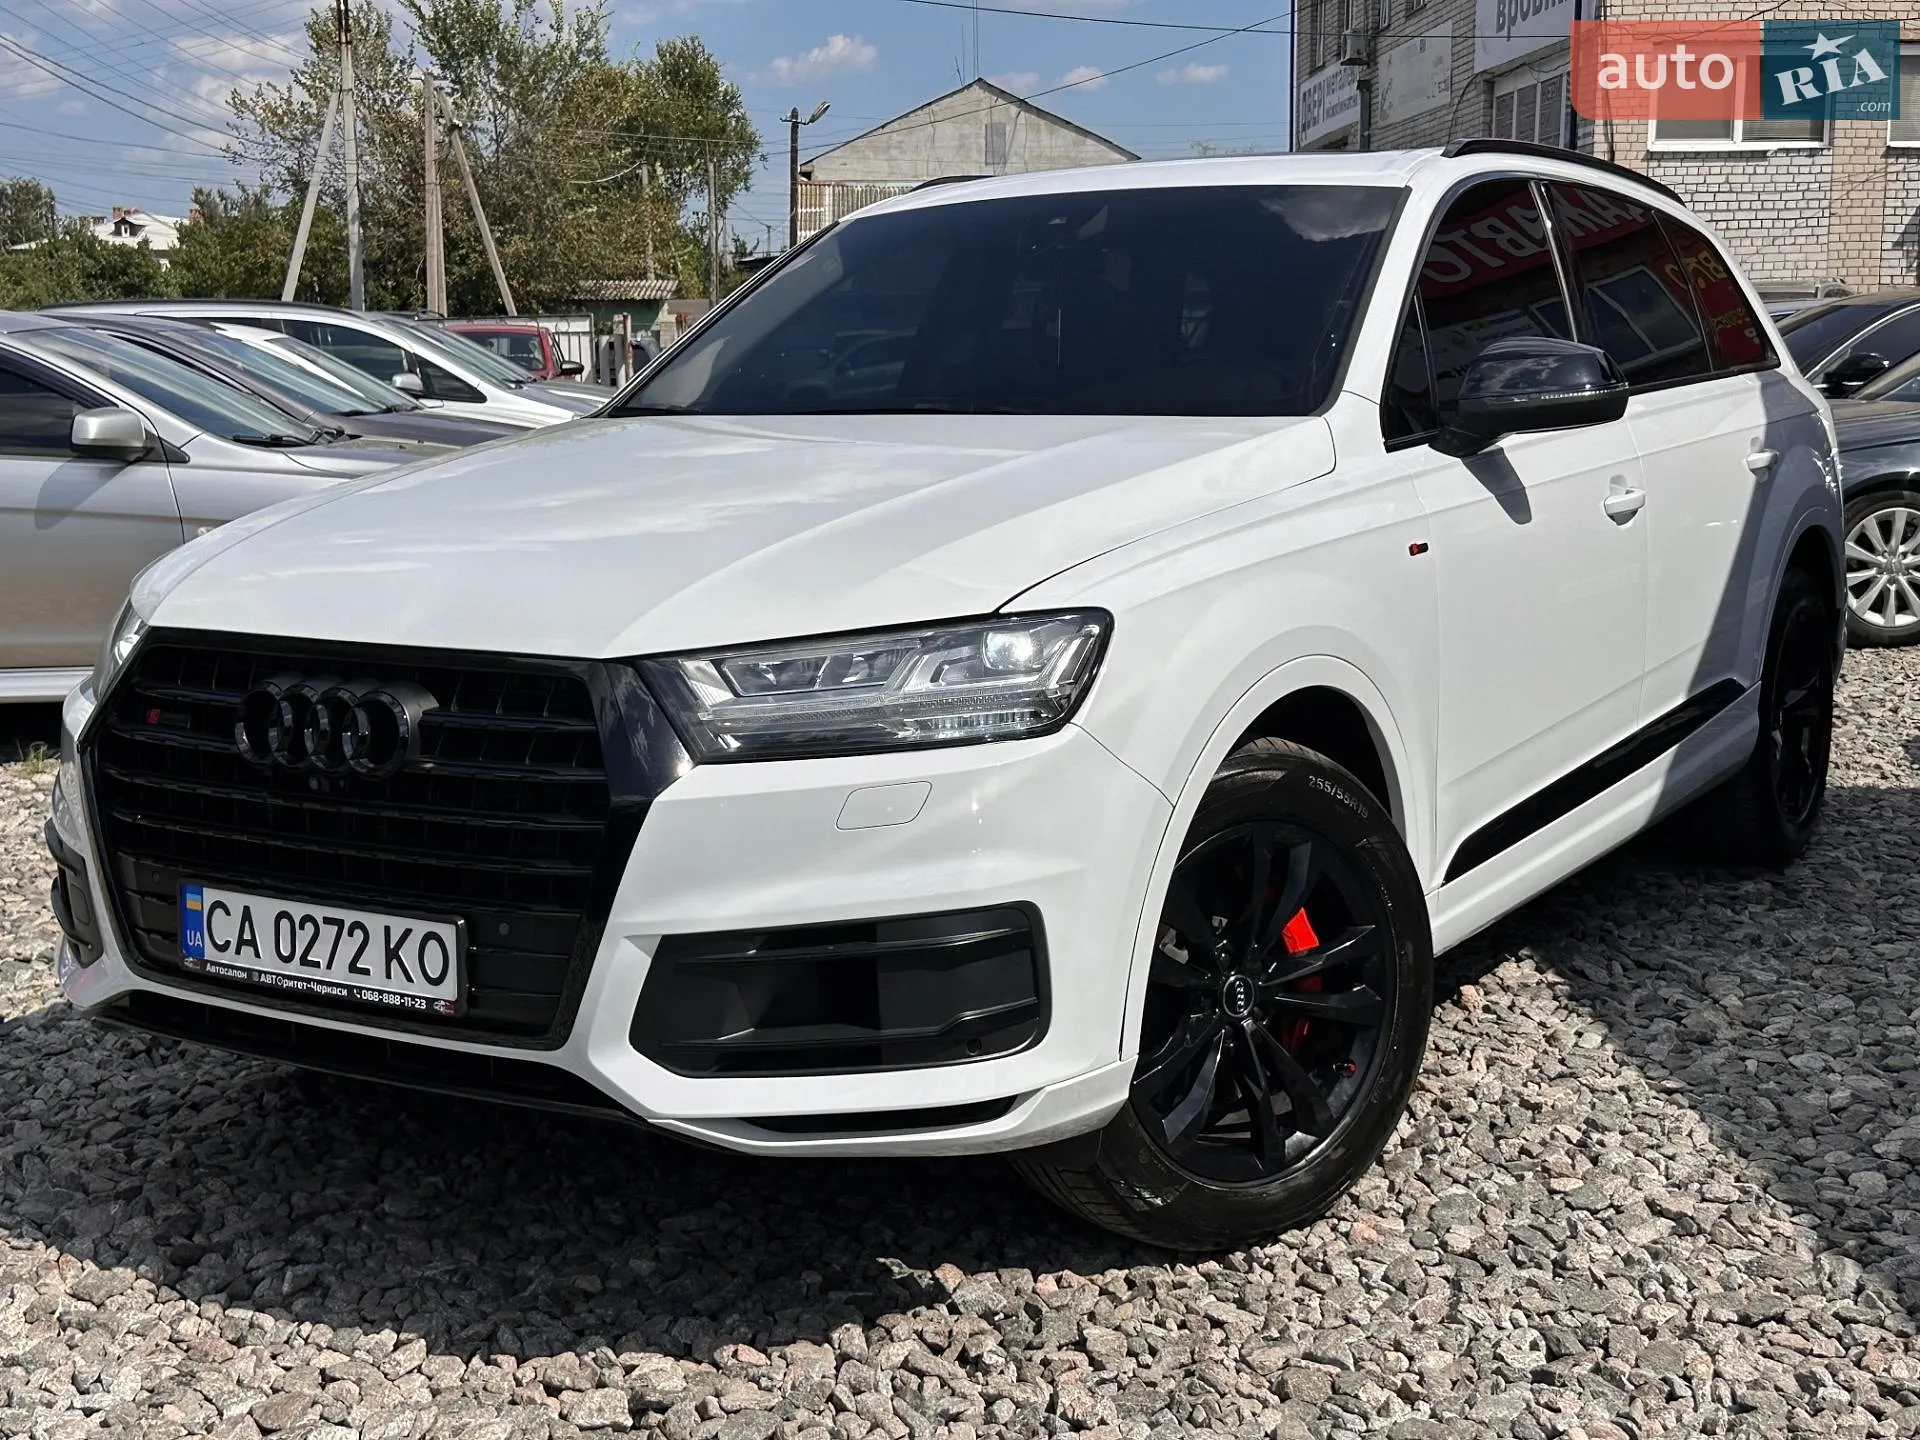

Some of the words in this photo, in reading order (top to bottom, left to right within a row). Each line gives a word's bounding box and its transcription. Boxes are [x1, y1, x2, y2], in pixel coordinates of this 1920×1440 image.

[187, 929, 203, 948] UA
[206, 900, 262, 959] CA
[274, 910, 372, 976] 0272
[384, 925, 450, 987] KO
[205, 963, 248, 979] Автосалон
[361, 990, 427, 1009] 068-888-11-23
